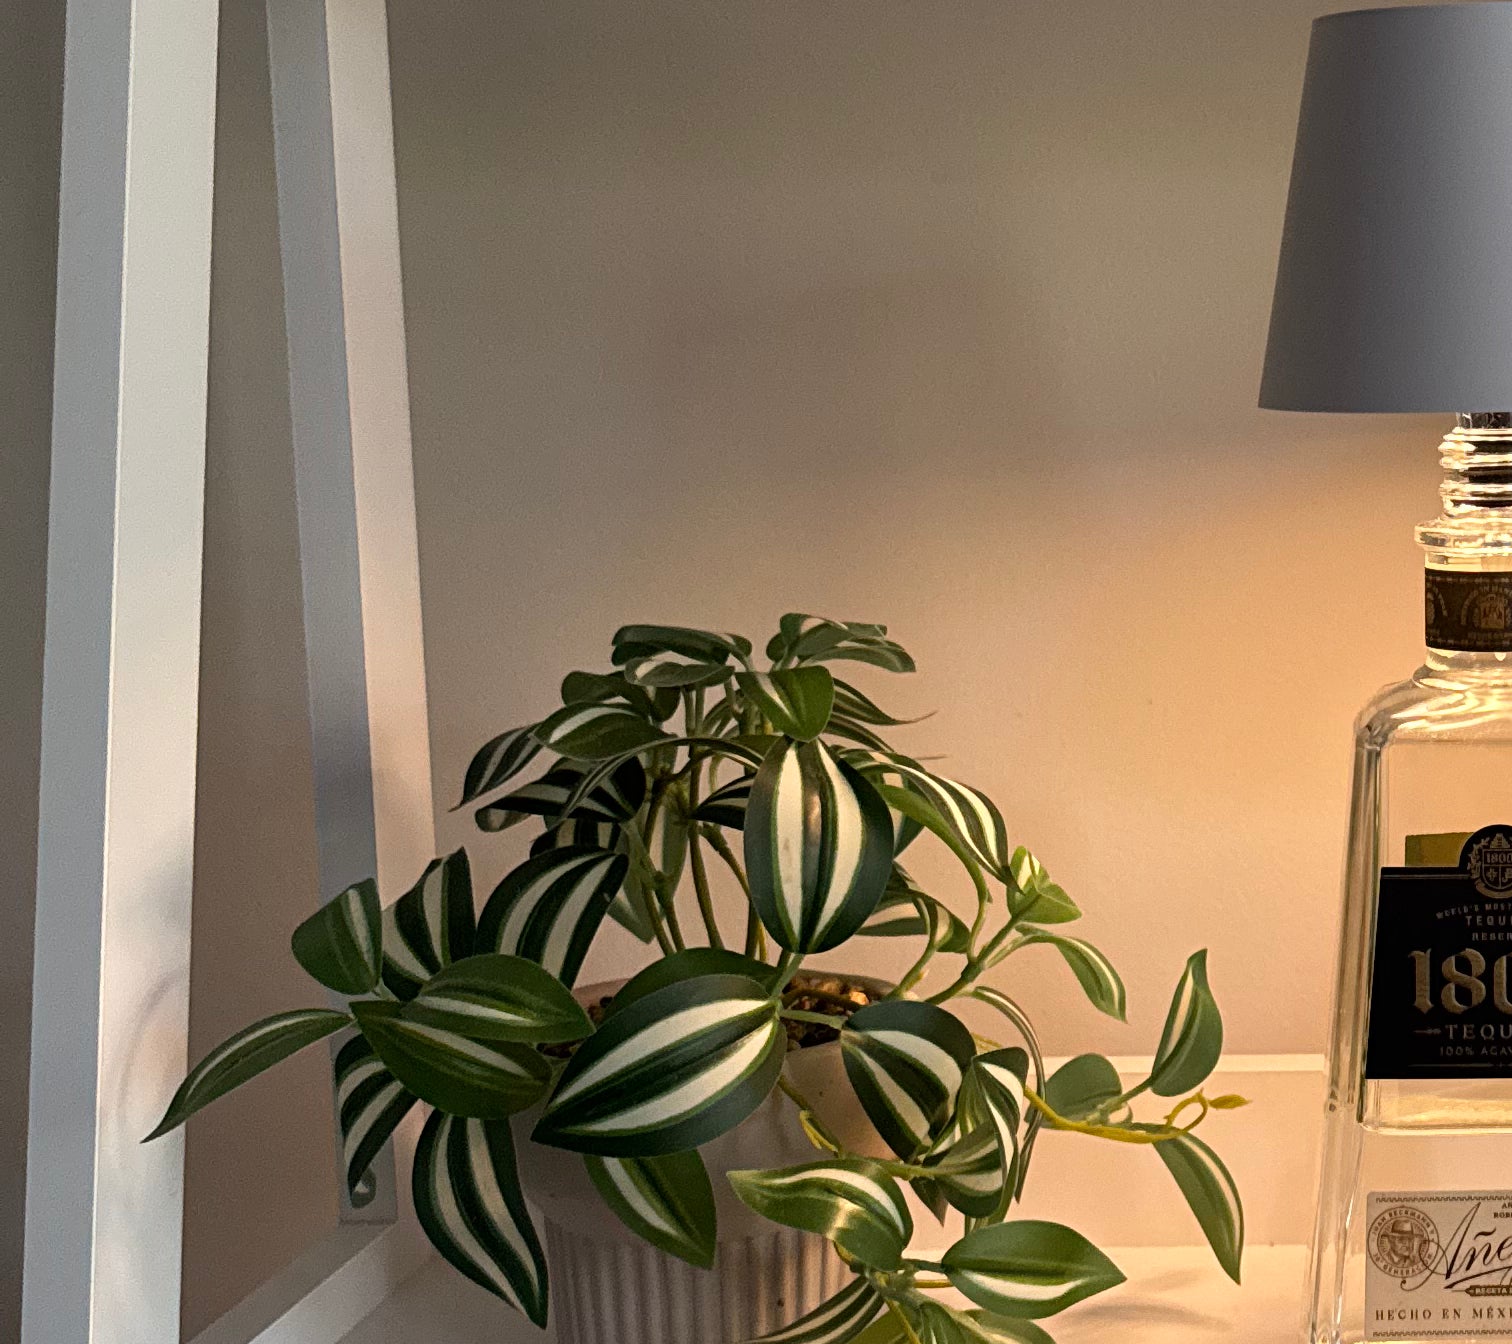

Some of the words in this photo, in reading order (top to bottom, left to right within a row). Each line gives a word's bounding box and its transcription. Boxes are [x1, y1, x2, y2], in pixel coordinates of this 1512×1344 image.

[1440, 1045, 1474, 1056] 100%
[1375, 1308, 1432, 1321] HECHO
[1442, 1307, 1461, 1320] EN
